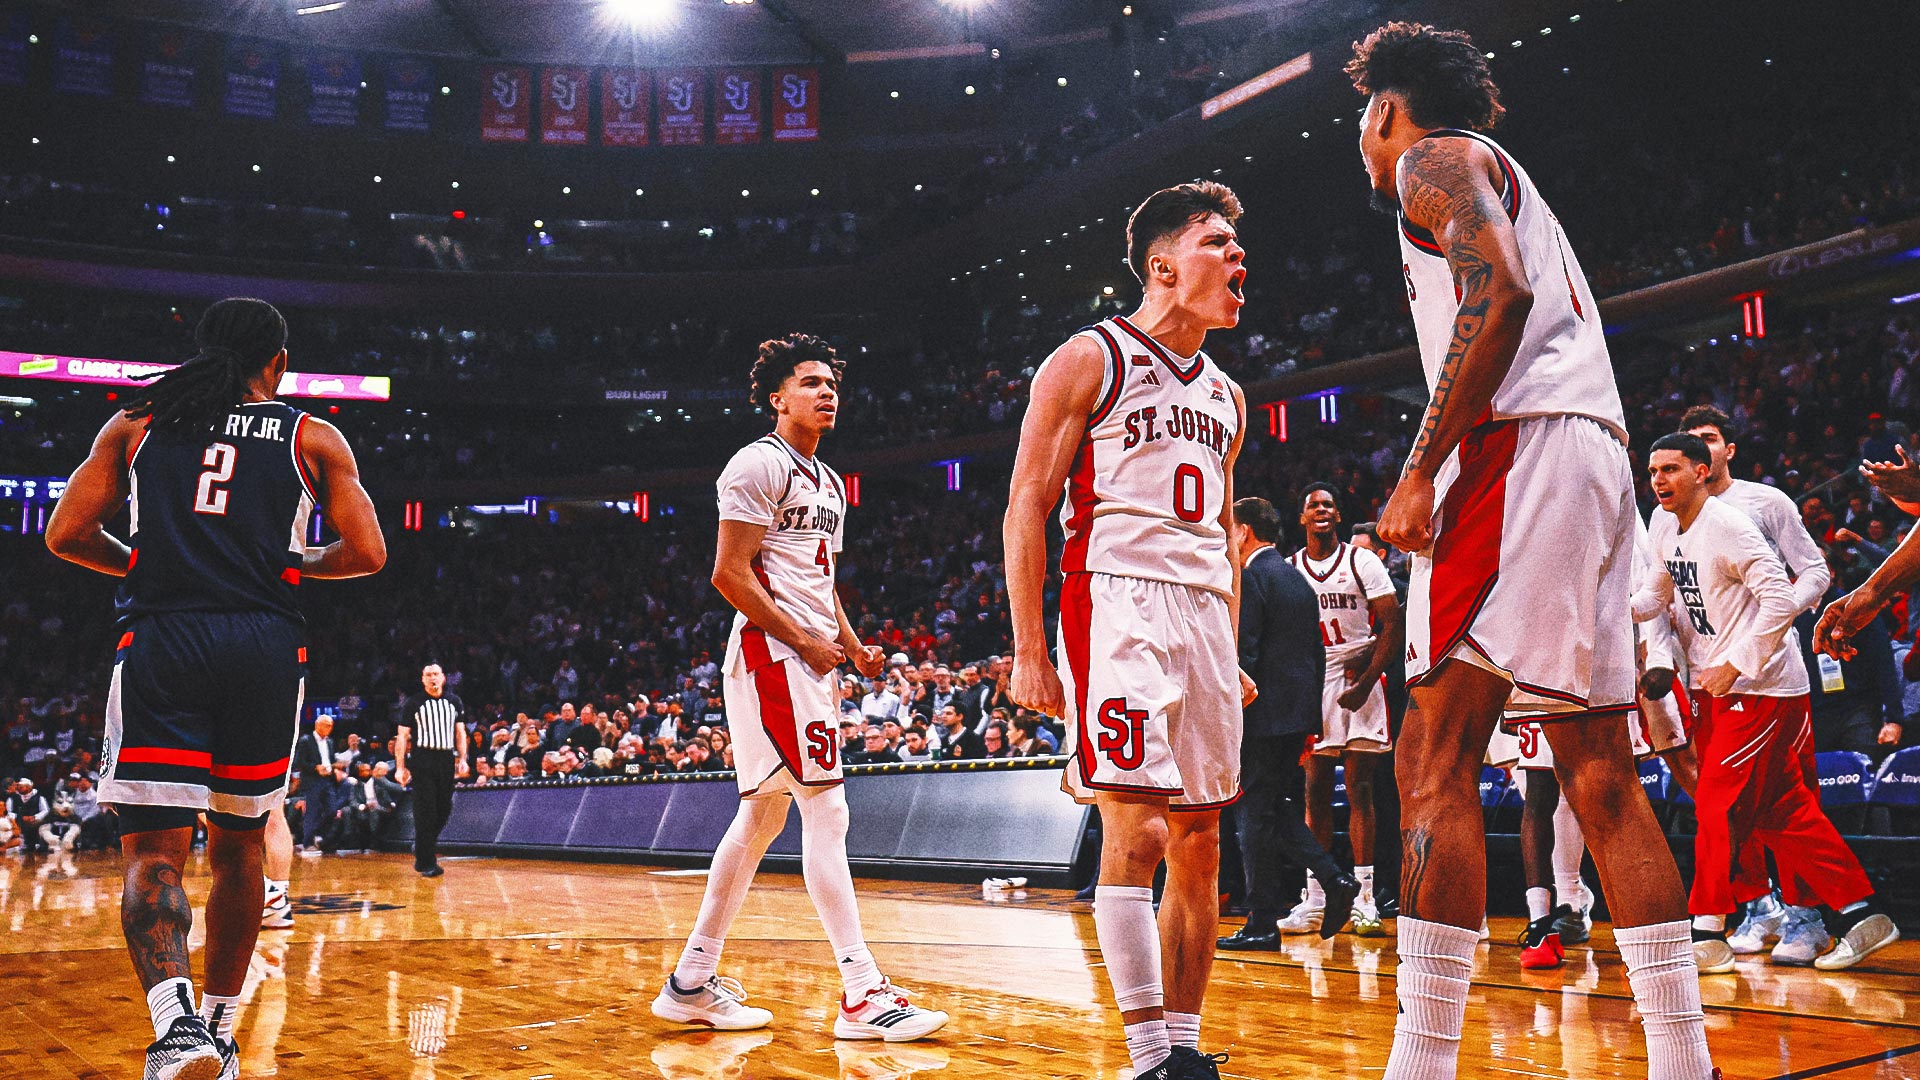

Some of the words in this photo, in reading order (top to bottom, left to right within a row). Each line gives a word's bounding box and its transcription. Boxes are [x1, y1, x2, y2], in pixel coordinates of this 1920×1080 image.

[782, 74, 809, 108] SJ
[67, 359, 122, 379] CLASSIC
[225, 413, 254, 437] RY
[253, 417, 284, 442] JR.
[1124, 406, 1162, 451] ST.
[194, 442, 238, 516] 2
[1173, 462, 1205, 523] 0
[777, 505, 809, 532] ST.
[815, 538, 830, 576] 4
[1319, 592, 1358, 610] OHN'S
[1318, 618, 1347, 647] 11
[805, 720, 837, 771] SJ
[1098, 697, 1150, 771] SJ
